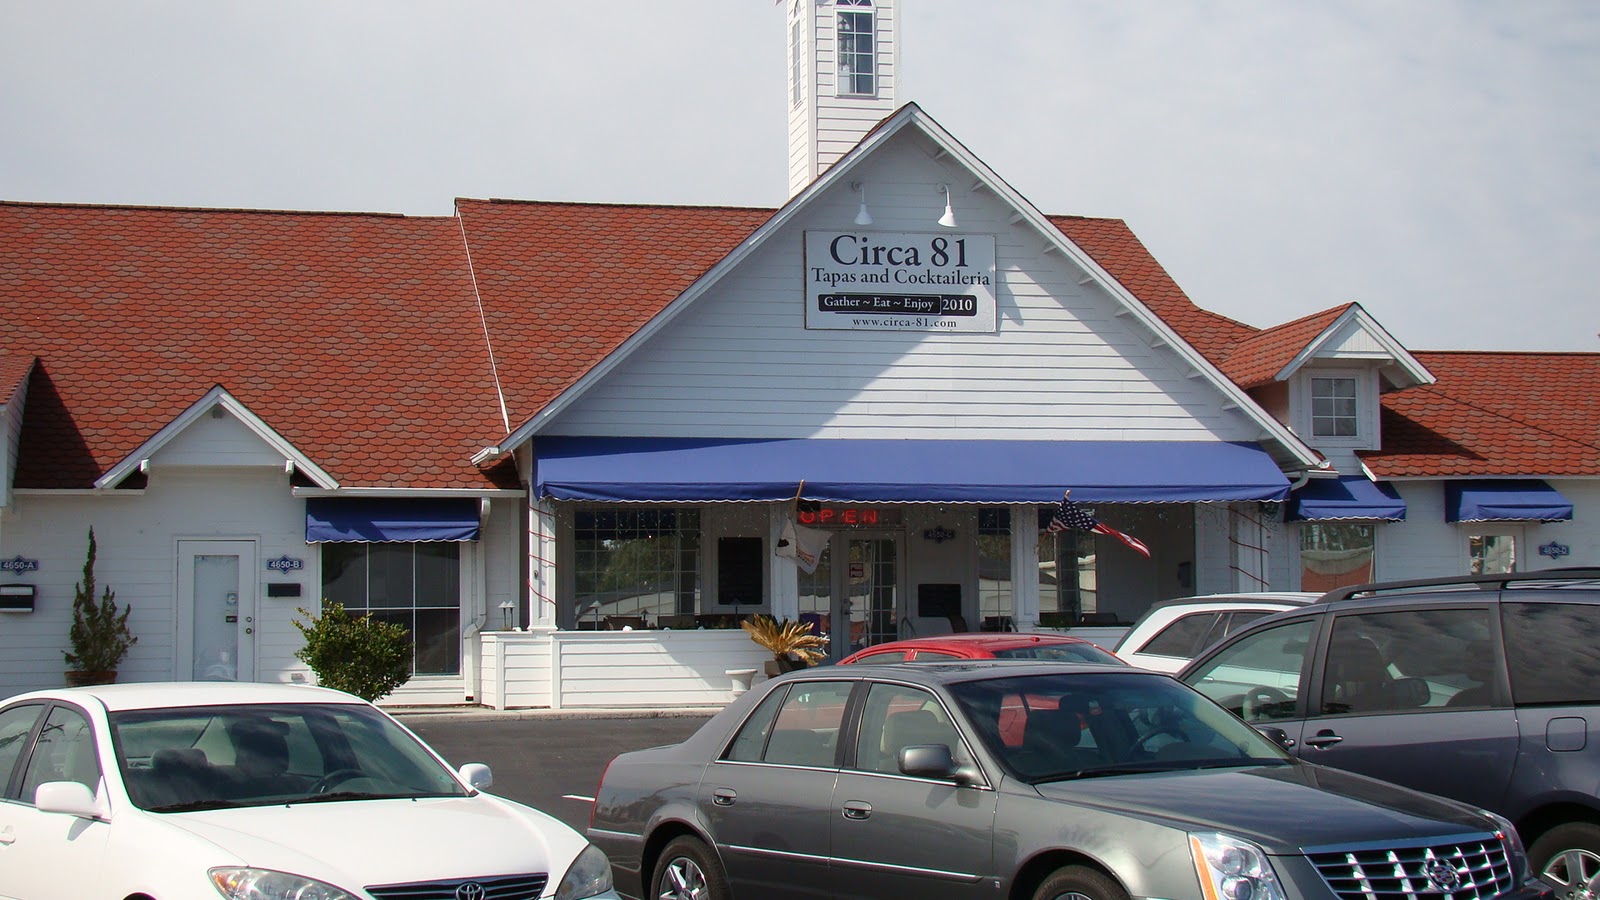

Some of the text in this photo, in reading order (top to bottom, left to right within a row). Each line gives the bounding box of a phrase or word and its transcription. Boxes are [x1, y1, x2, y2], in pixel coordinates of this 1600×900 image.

[830, 235, 968, 267] Circa 81
[811, 267, 990, 287] Tapas and Cocktaileria
[824, 296, 860, 307] Gather
[873, 298, 890, 307] Eat
[904, 298, 933, 311] Enjoy
[942, 299, 973, 311] 2010
[852, 318, 957, 328] www.circa-81.com
[800, 509, 877, 523] OPEN
